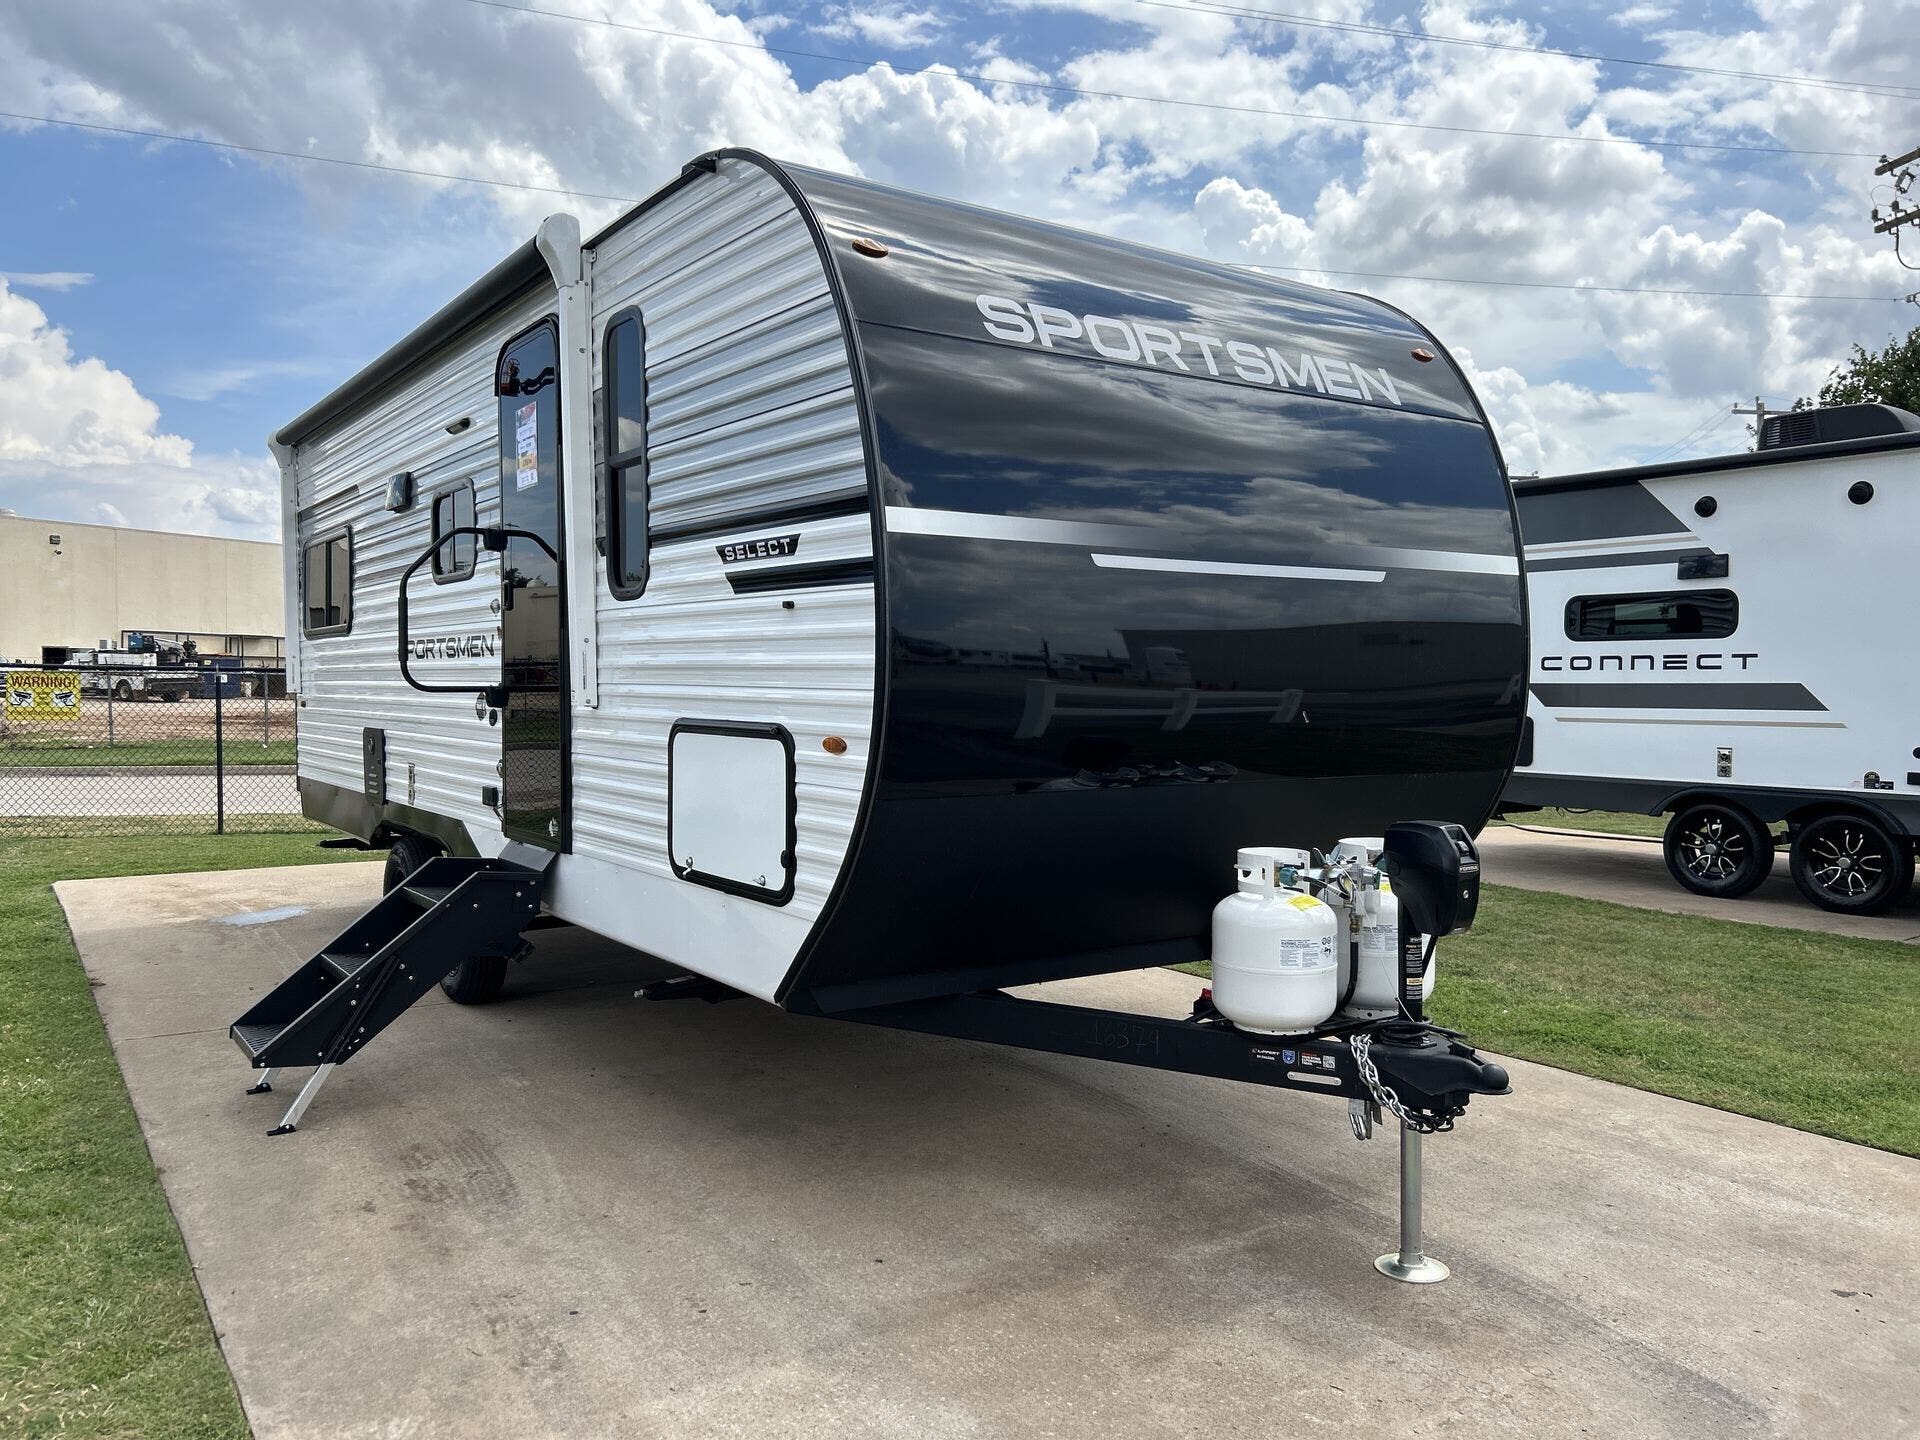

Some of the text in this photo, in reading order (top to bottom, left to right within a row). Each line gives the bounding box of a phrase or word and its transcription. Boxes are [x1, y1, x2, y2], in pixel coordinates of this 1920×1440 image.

[975, 294, 1402, 406] SPORTSMEN
[724, 538, 790, 561] SELECT
[407, 634, 495, 659] PORTSMEN
[1540, 653, 1759, 671] CONNECT
[11, 675, 76, 688] WARNING!
